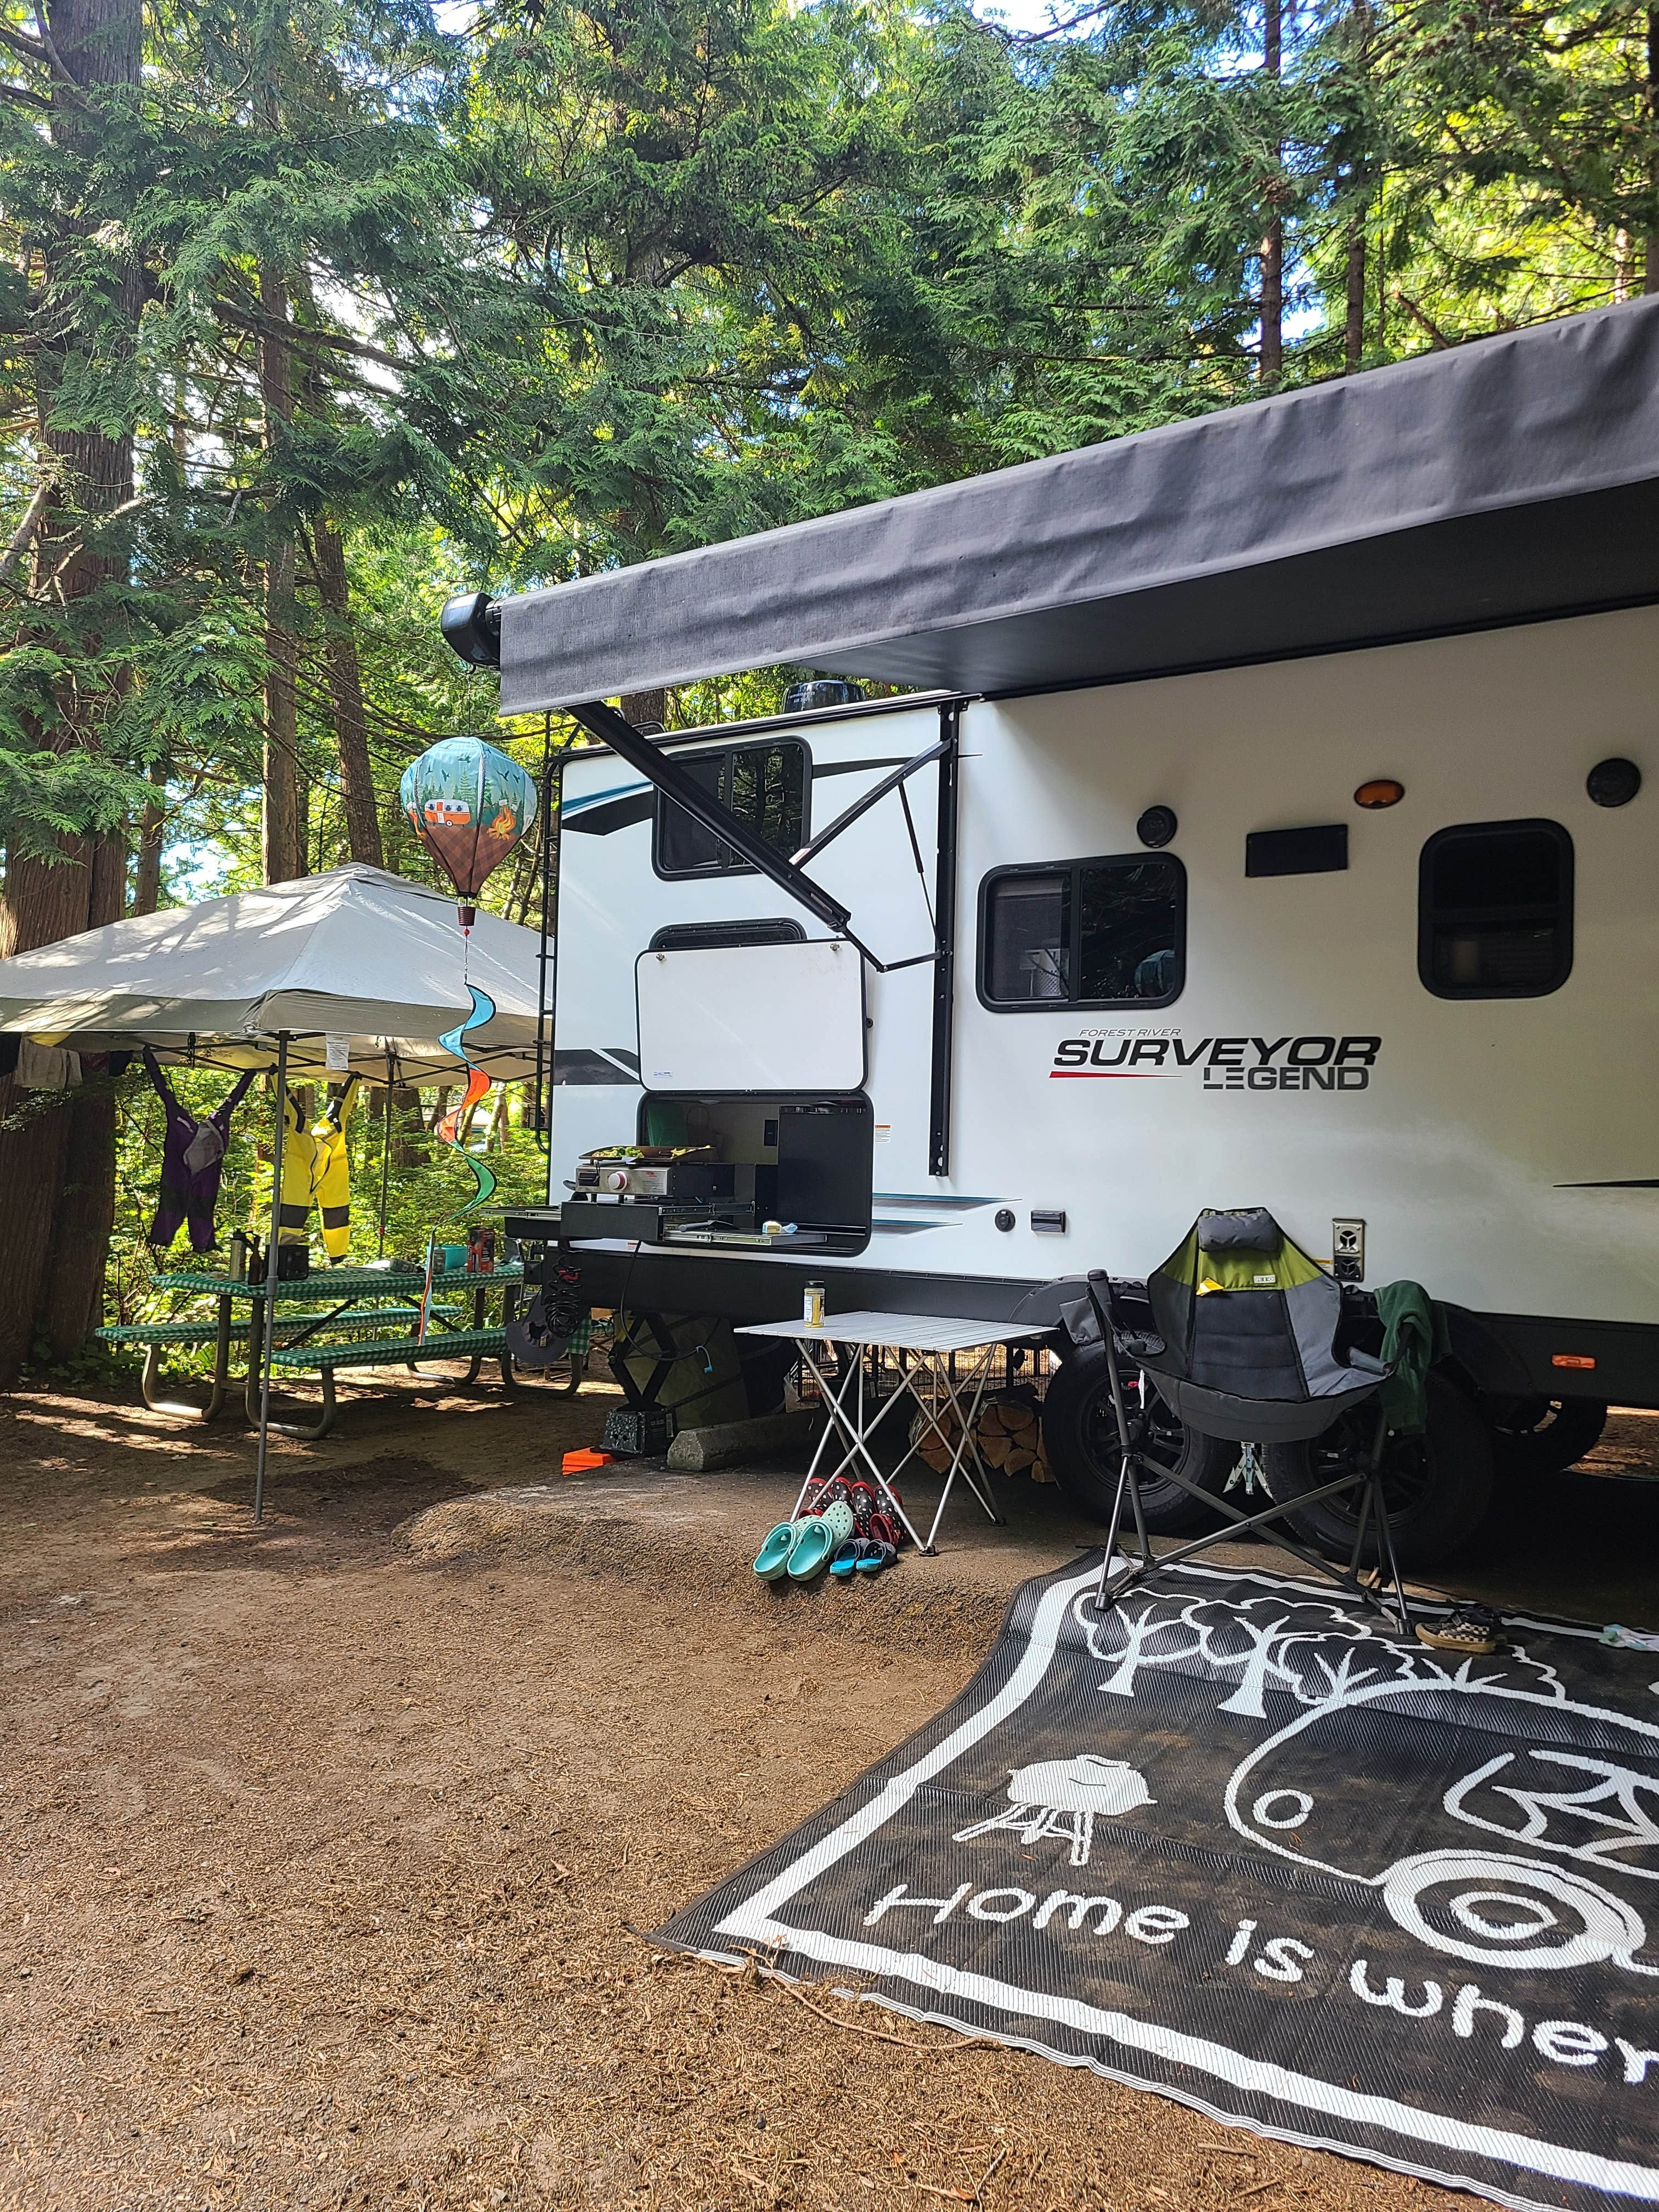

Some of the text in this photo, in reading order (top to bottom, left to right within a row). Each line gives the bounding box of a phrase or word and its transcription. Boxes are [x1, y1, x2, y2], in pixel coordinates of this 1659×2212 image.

[1054, 1036, 1382, 1066] SURVEYOR
[1203, 1066, 1369, 1091] LEGEND
[861, 1881, 1191, 1945] Home
[1225, 1917, 1315, 1983] is
